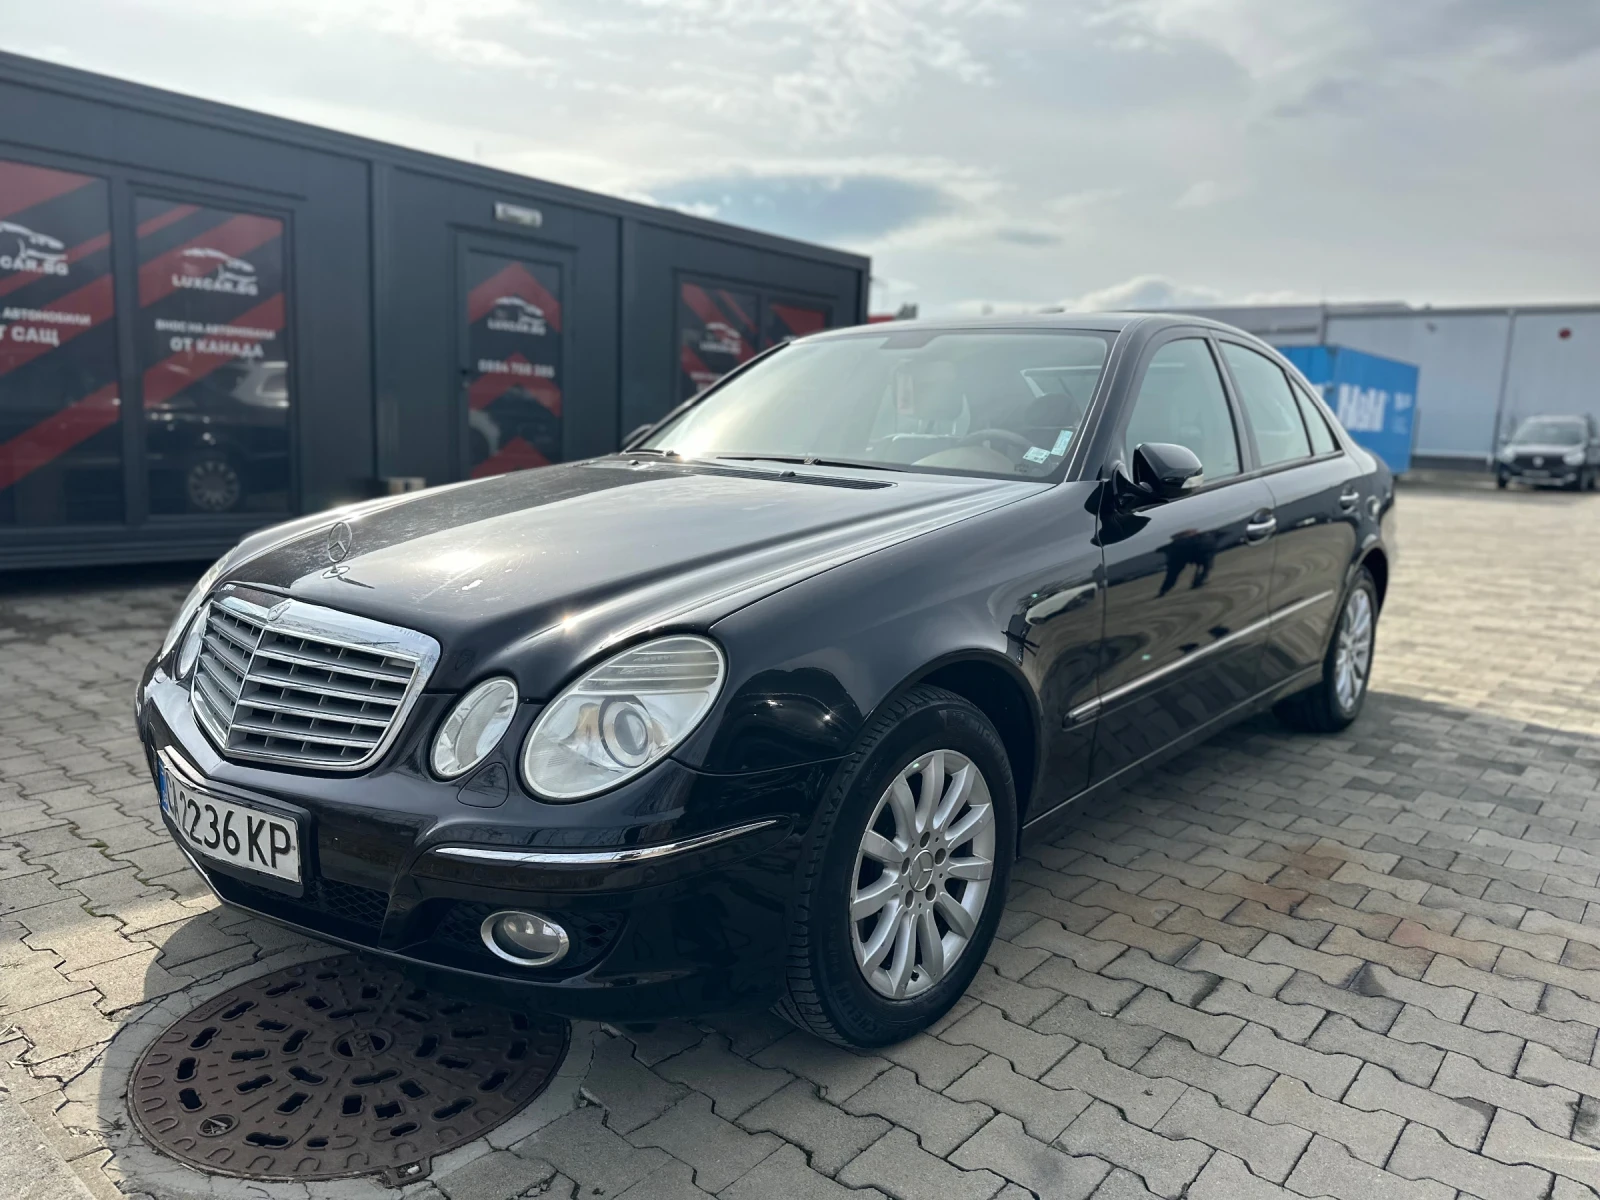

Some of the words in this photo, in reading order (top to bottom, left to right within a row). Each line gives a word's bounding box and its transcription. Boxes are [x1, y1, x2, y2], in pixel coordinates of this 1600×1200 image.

[3, 307, 91, 326] АВТОМОБИЛИ
[11, 326, 60, 346] САЩ
[169, 336, 194, 352] ОТ
[196, 339, 265, 359] КАНАДА
